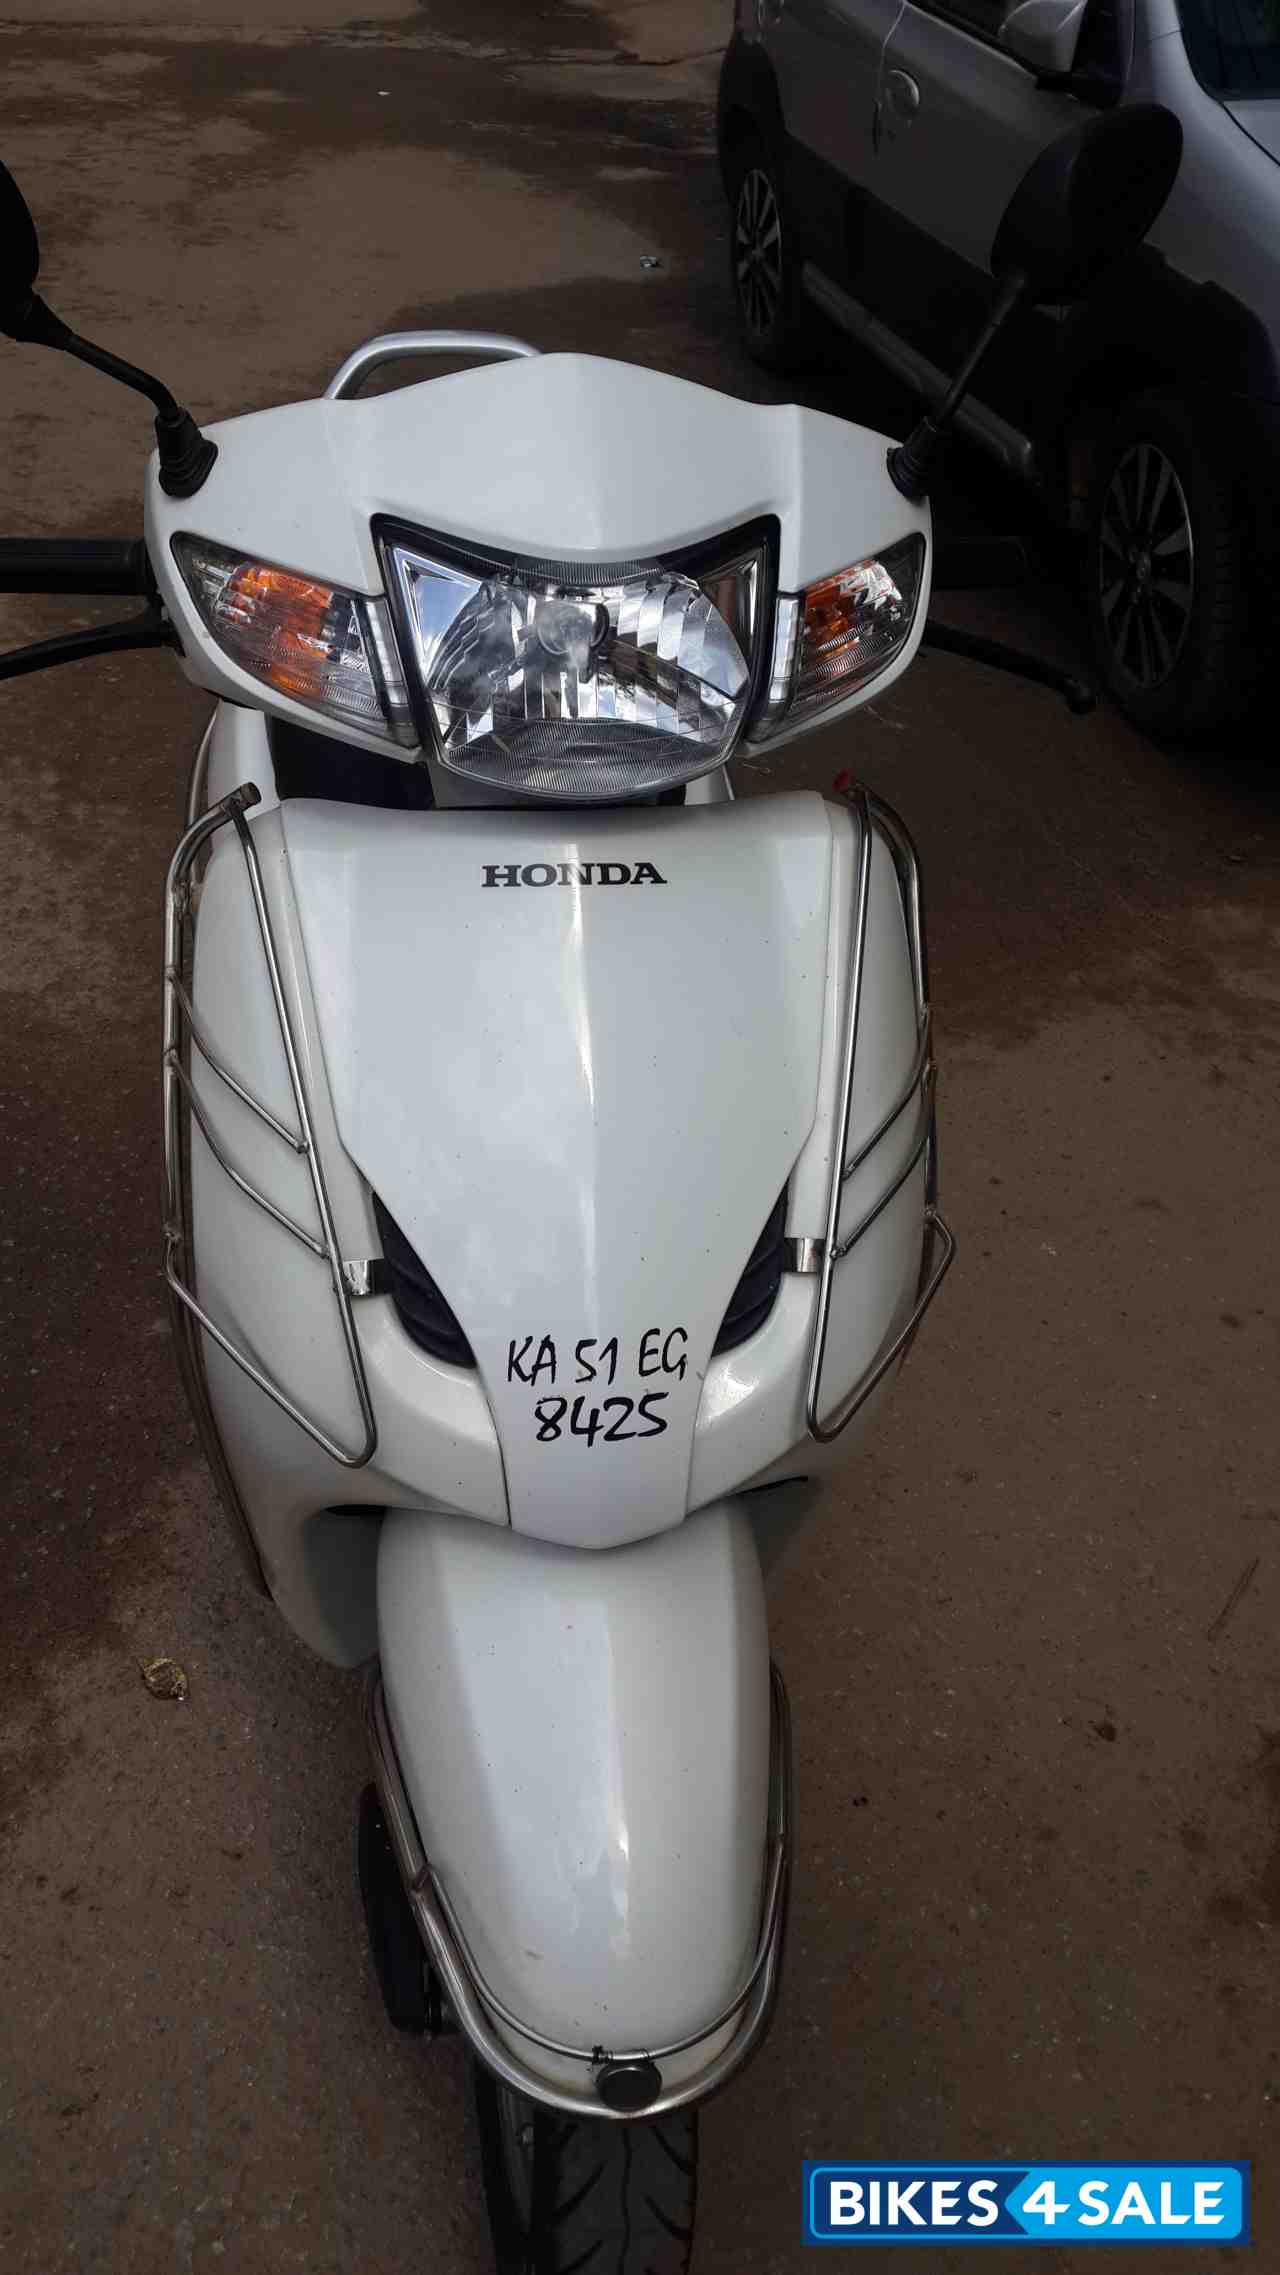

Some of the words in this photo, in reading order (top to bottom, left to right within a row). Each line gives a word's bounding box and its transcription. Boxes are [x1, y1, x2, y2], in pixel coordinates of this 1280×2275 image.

[481, 862, 668, 888] HONDA
[507, 1334, 557, 1387] KA
[575, 1336, 618, 1386] 51
[638, 1327, 688, 1381] EG
[534, 1392, 670, 1448] 8425
